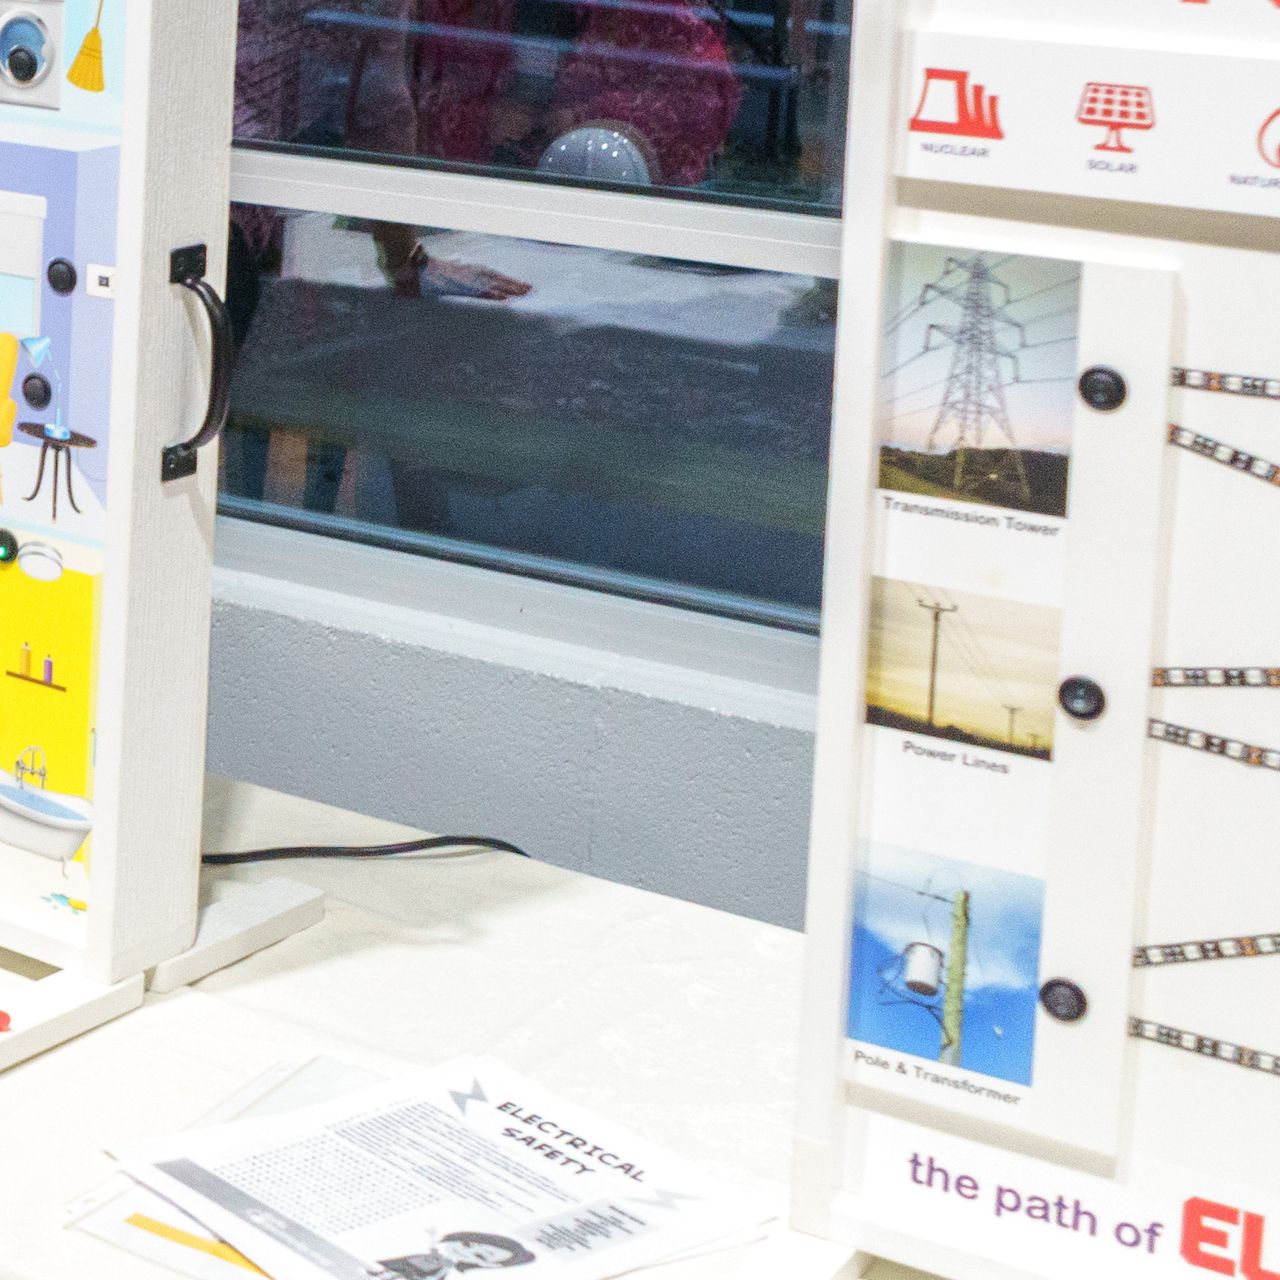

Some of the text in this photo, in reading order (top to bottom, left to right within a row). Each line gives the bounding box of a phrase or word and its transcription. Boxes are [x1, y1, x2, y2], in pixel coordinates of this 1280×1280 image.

[921, 142, 991, 158] NUCLEAR
[1087, 159, 1138, 175] SOLAR
[884, 496, 1060, 536] Transmission Tower
[903, 740, 1009, 774] Power Lines
[854, 1049, 1021, 1105] Pole & Transformer
[495, 1100, 647, 1183] ELECTRICAL
[501, 1126, 595, 1175] SAFETY
[908, 1152, 980, 1200] the
[994, 1184, 1098, 1236] path
[1114, 1221, 1164, 1253] of
